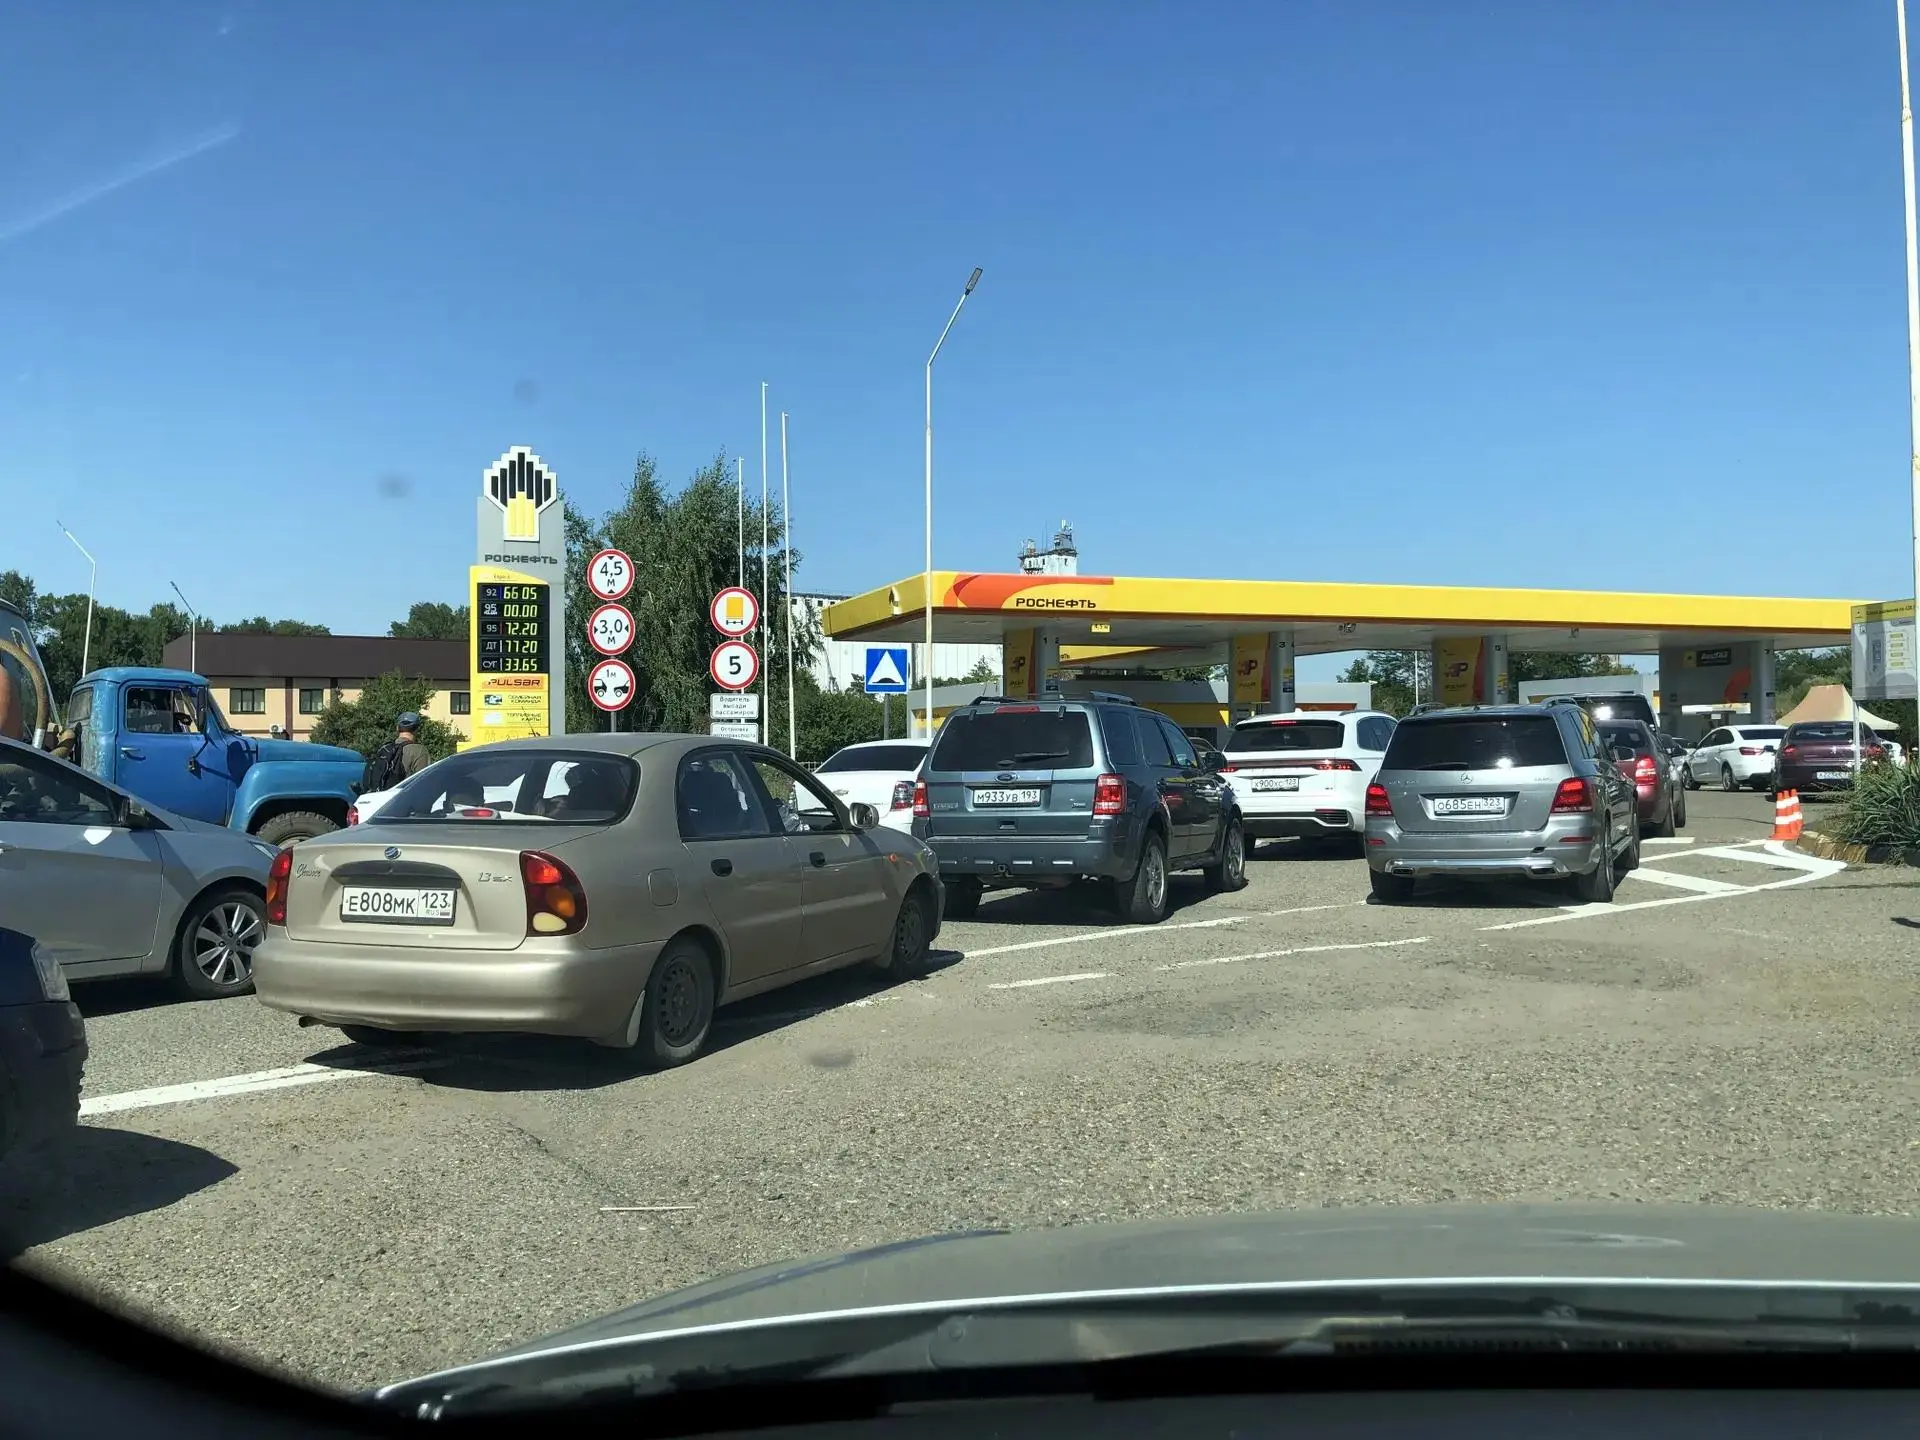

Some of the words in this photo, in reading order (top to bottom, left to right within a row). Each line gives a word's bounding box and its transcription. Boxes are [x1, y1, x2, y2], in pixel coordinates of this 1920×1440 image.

[484, 554, 558, 565] РОСНЕФТЬ
[599, 561, 623, 578] 4,5
[486, 588, 497, 597] 92
[484, 603, 497, 612] 95
[503, 604, 538, 618] 00.00
[1015, 598, 1097, 609] РОСНЕФТЬ
[486, 624, 497, 632] 95
[505, 622, 538, 636] 72.20
[599, 619, 623, 635] 3,0
[485, 641, 498, 650] ДТ
[482, 660, 498, 669] СУГ
[504, 658, 538, 672] 33.65
[729, 655, 742, 675] 5
[976, 791, 1018, 803] М933УВ
[1021, 790, 1037, 800] 193
[1437, 799, 1481, 811] О685ЕН
[1483, 797, 1501, 807] 323
[348, 891, 416, 914] Е808МК
[421, 892, 448, 909] 123
